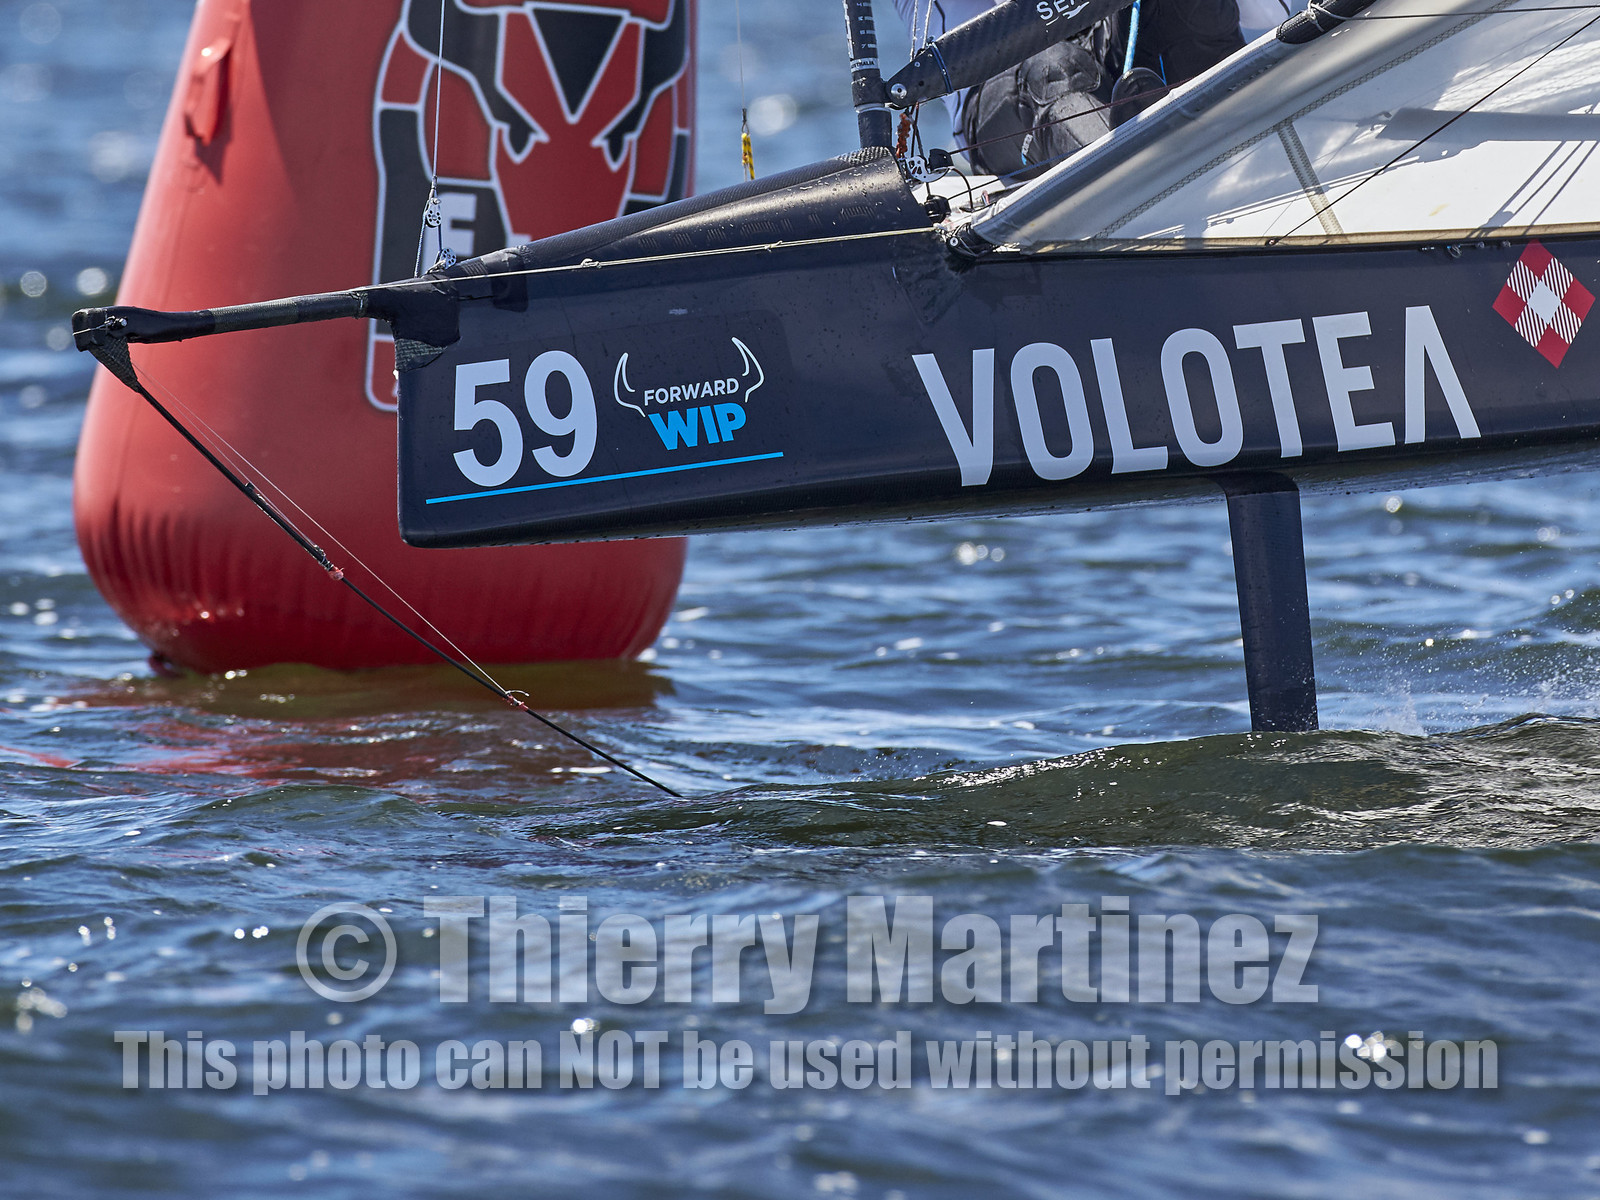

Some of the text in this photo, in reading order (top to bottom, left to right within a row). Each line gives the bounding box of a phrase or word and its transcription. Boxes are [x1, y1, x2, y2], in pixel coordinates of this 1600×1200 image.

[452, 350, 598, 487] 59
[643, 377, 740, 407] FORWARD
[647, 402, 748, 450] WIP
[911, 305, 1481, 487] VOLOTEA
